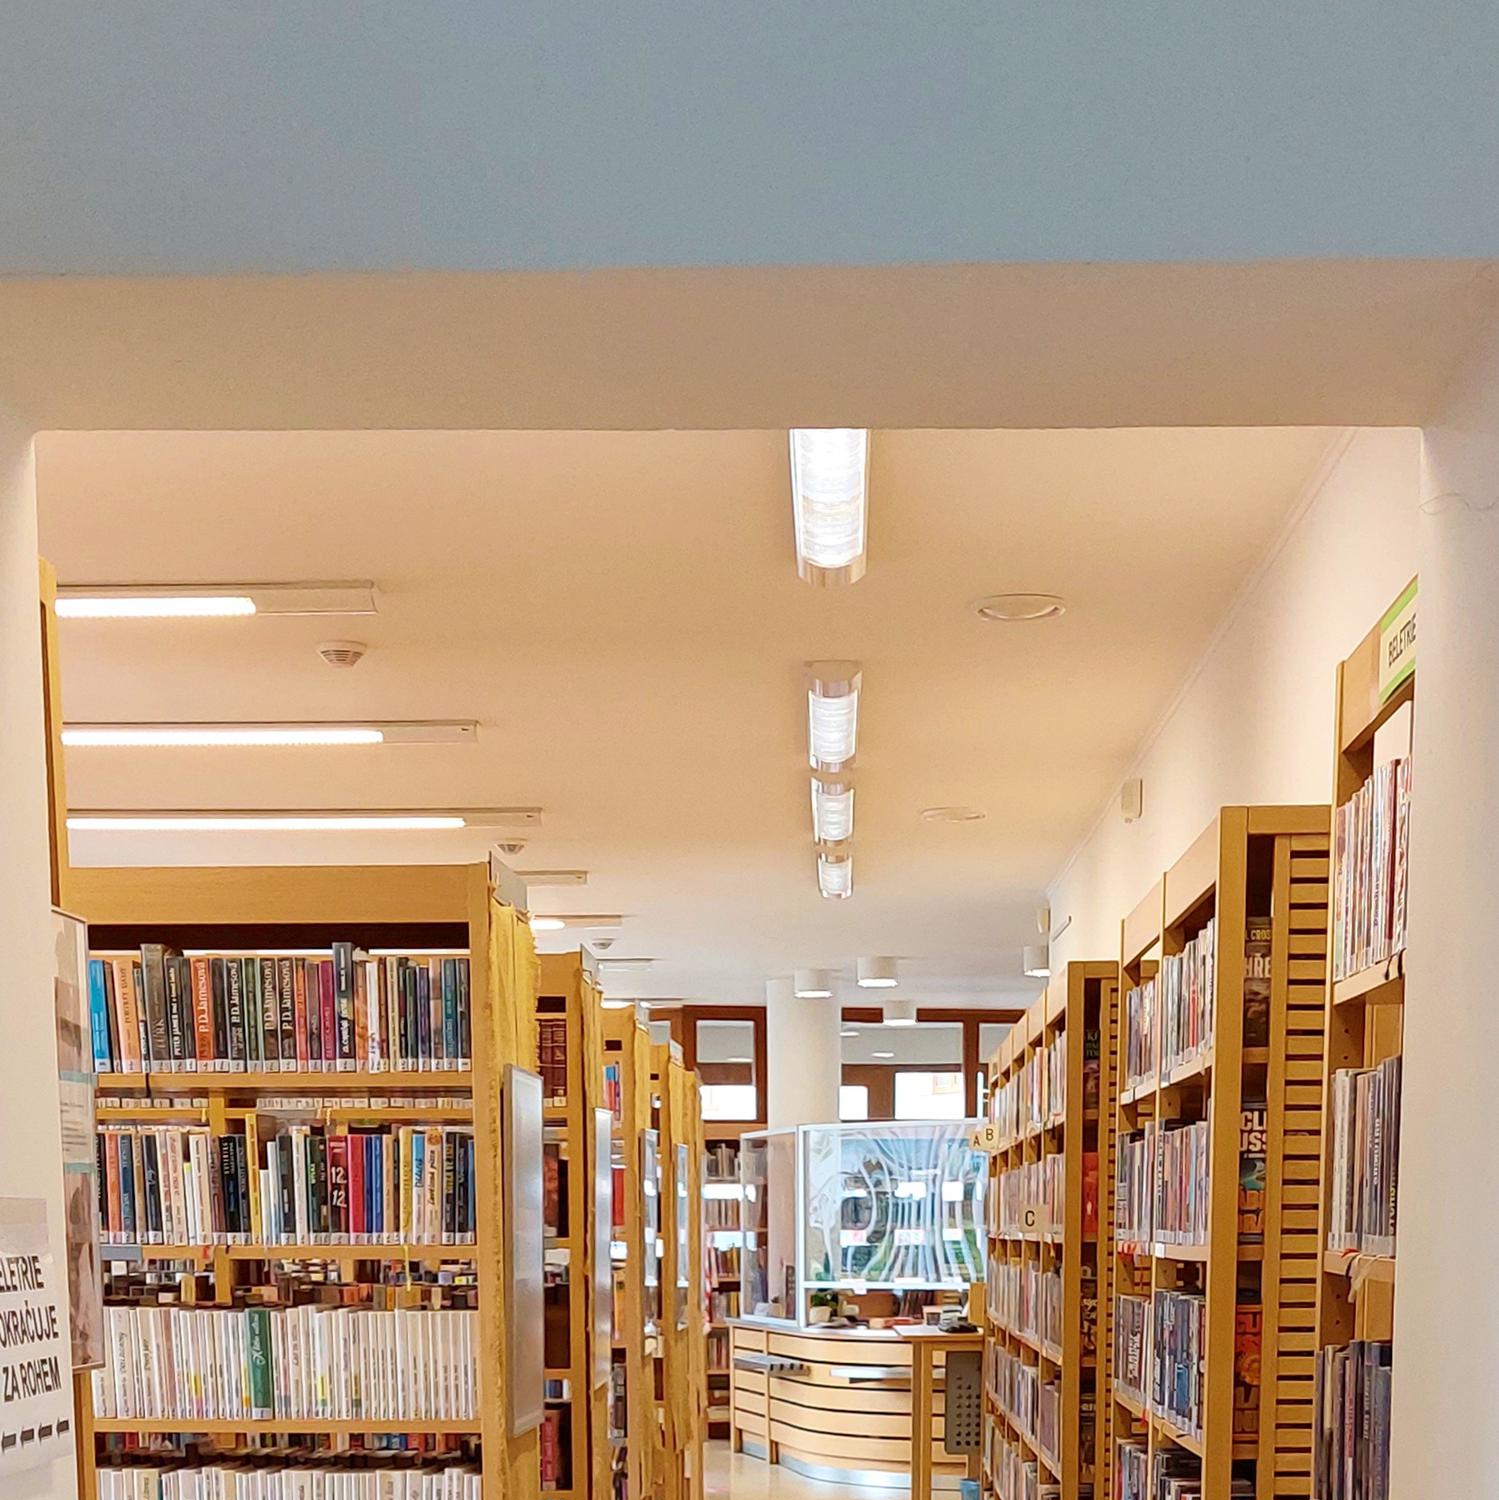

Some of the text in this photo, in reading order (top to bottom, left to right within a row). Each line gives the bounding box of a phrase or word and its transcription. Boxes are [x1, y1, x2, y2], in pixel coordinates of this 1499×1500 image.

[1388, 612, 1417, 668] BELETRIE
[973, 1135, 981, 1147] A
[985, 1128, 994, 1141] B
[331, 1167, 347, 1184] 12
[332, 1190, 348, 1208] 12
[1025, 1210, 1035, 1227] C
[3, 1356, 62, 1402] ZA ROHEM
